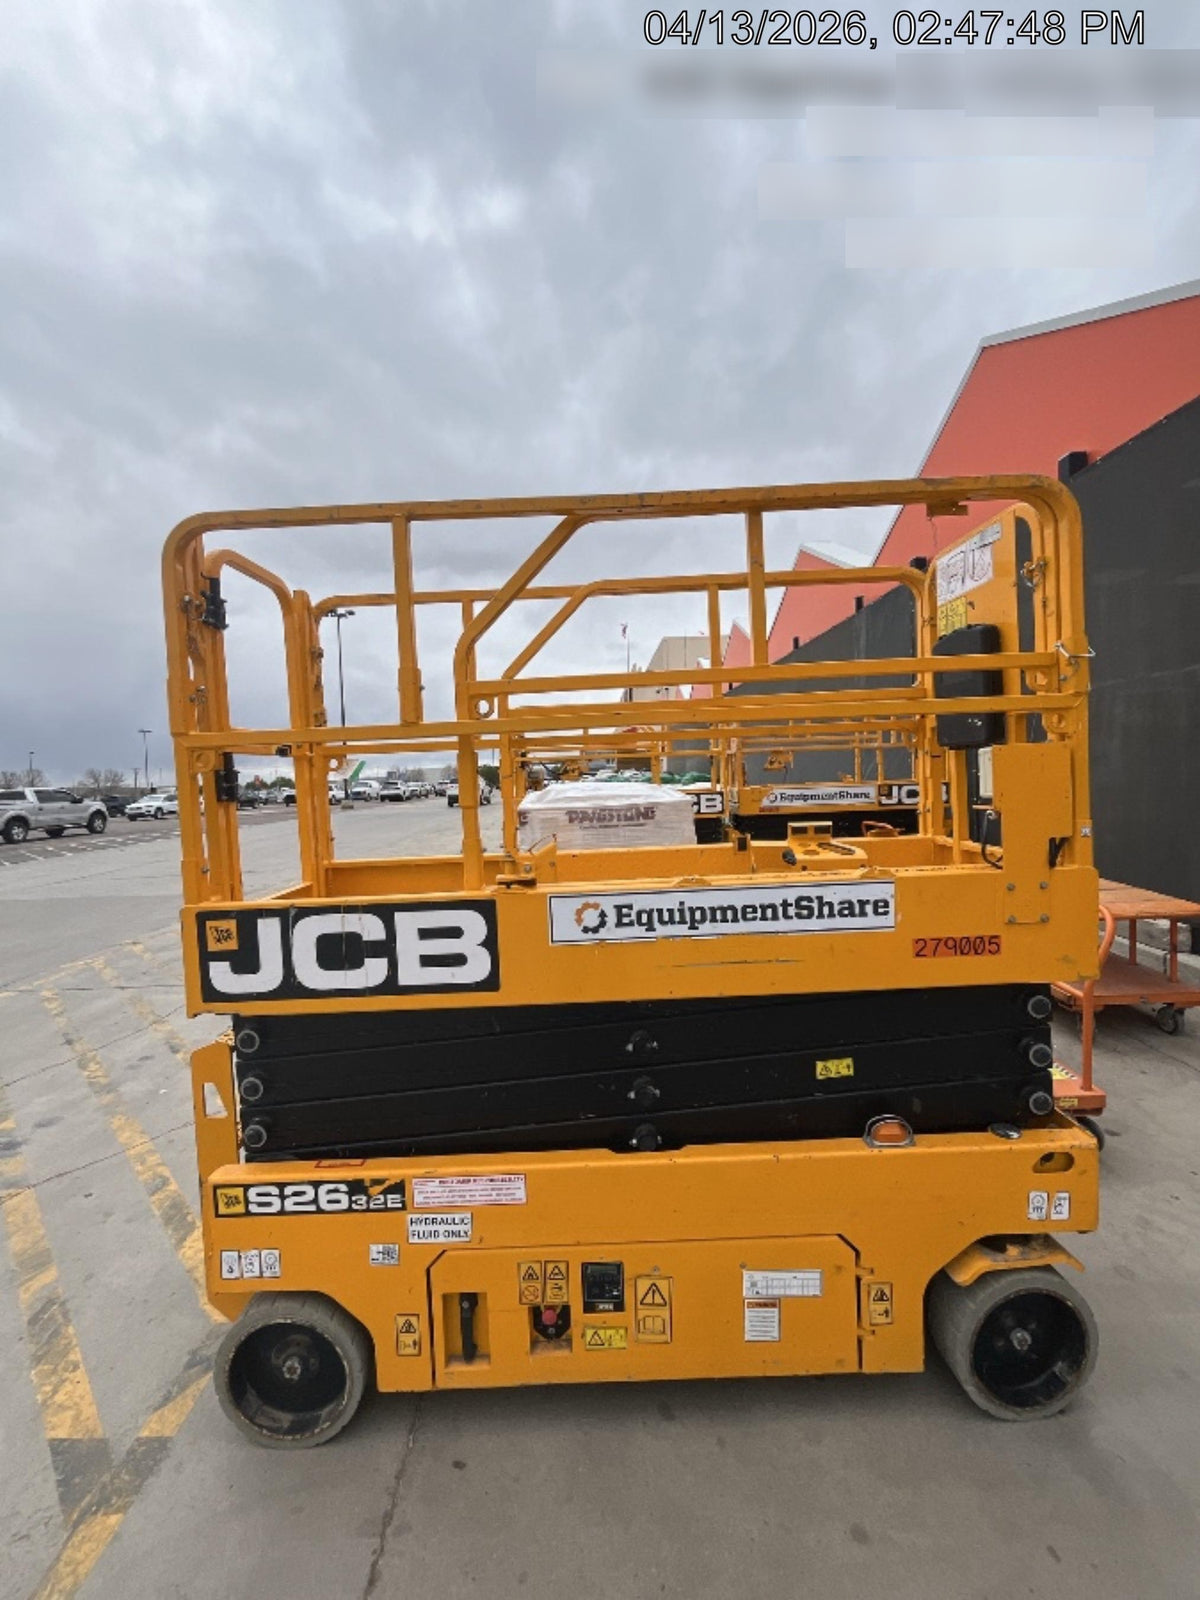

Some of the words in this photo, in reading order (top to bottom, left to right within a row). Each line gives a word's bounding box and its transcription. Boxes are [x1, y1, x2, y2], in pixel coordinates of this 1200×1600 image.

[613, 894, 891, 933] EquipmentShare
[208, 909, 492, 994] JCB
[914, 935, 1001, 957] 279005
[410, 1216, 470, 1227] HYDRAULIC
[411, 1229, 440, 1240] FLUID
[442, 1228, 469, 1239] ONLY
